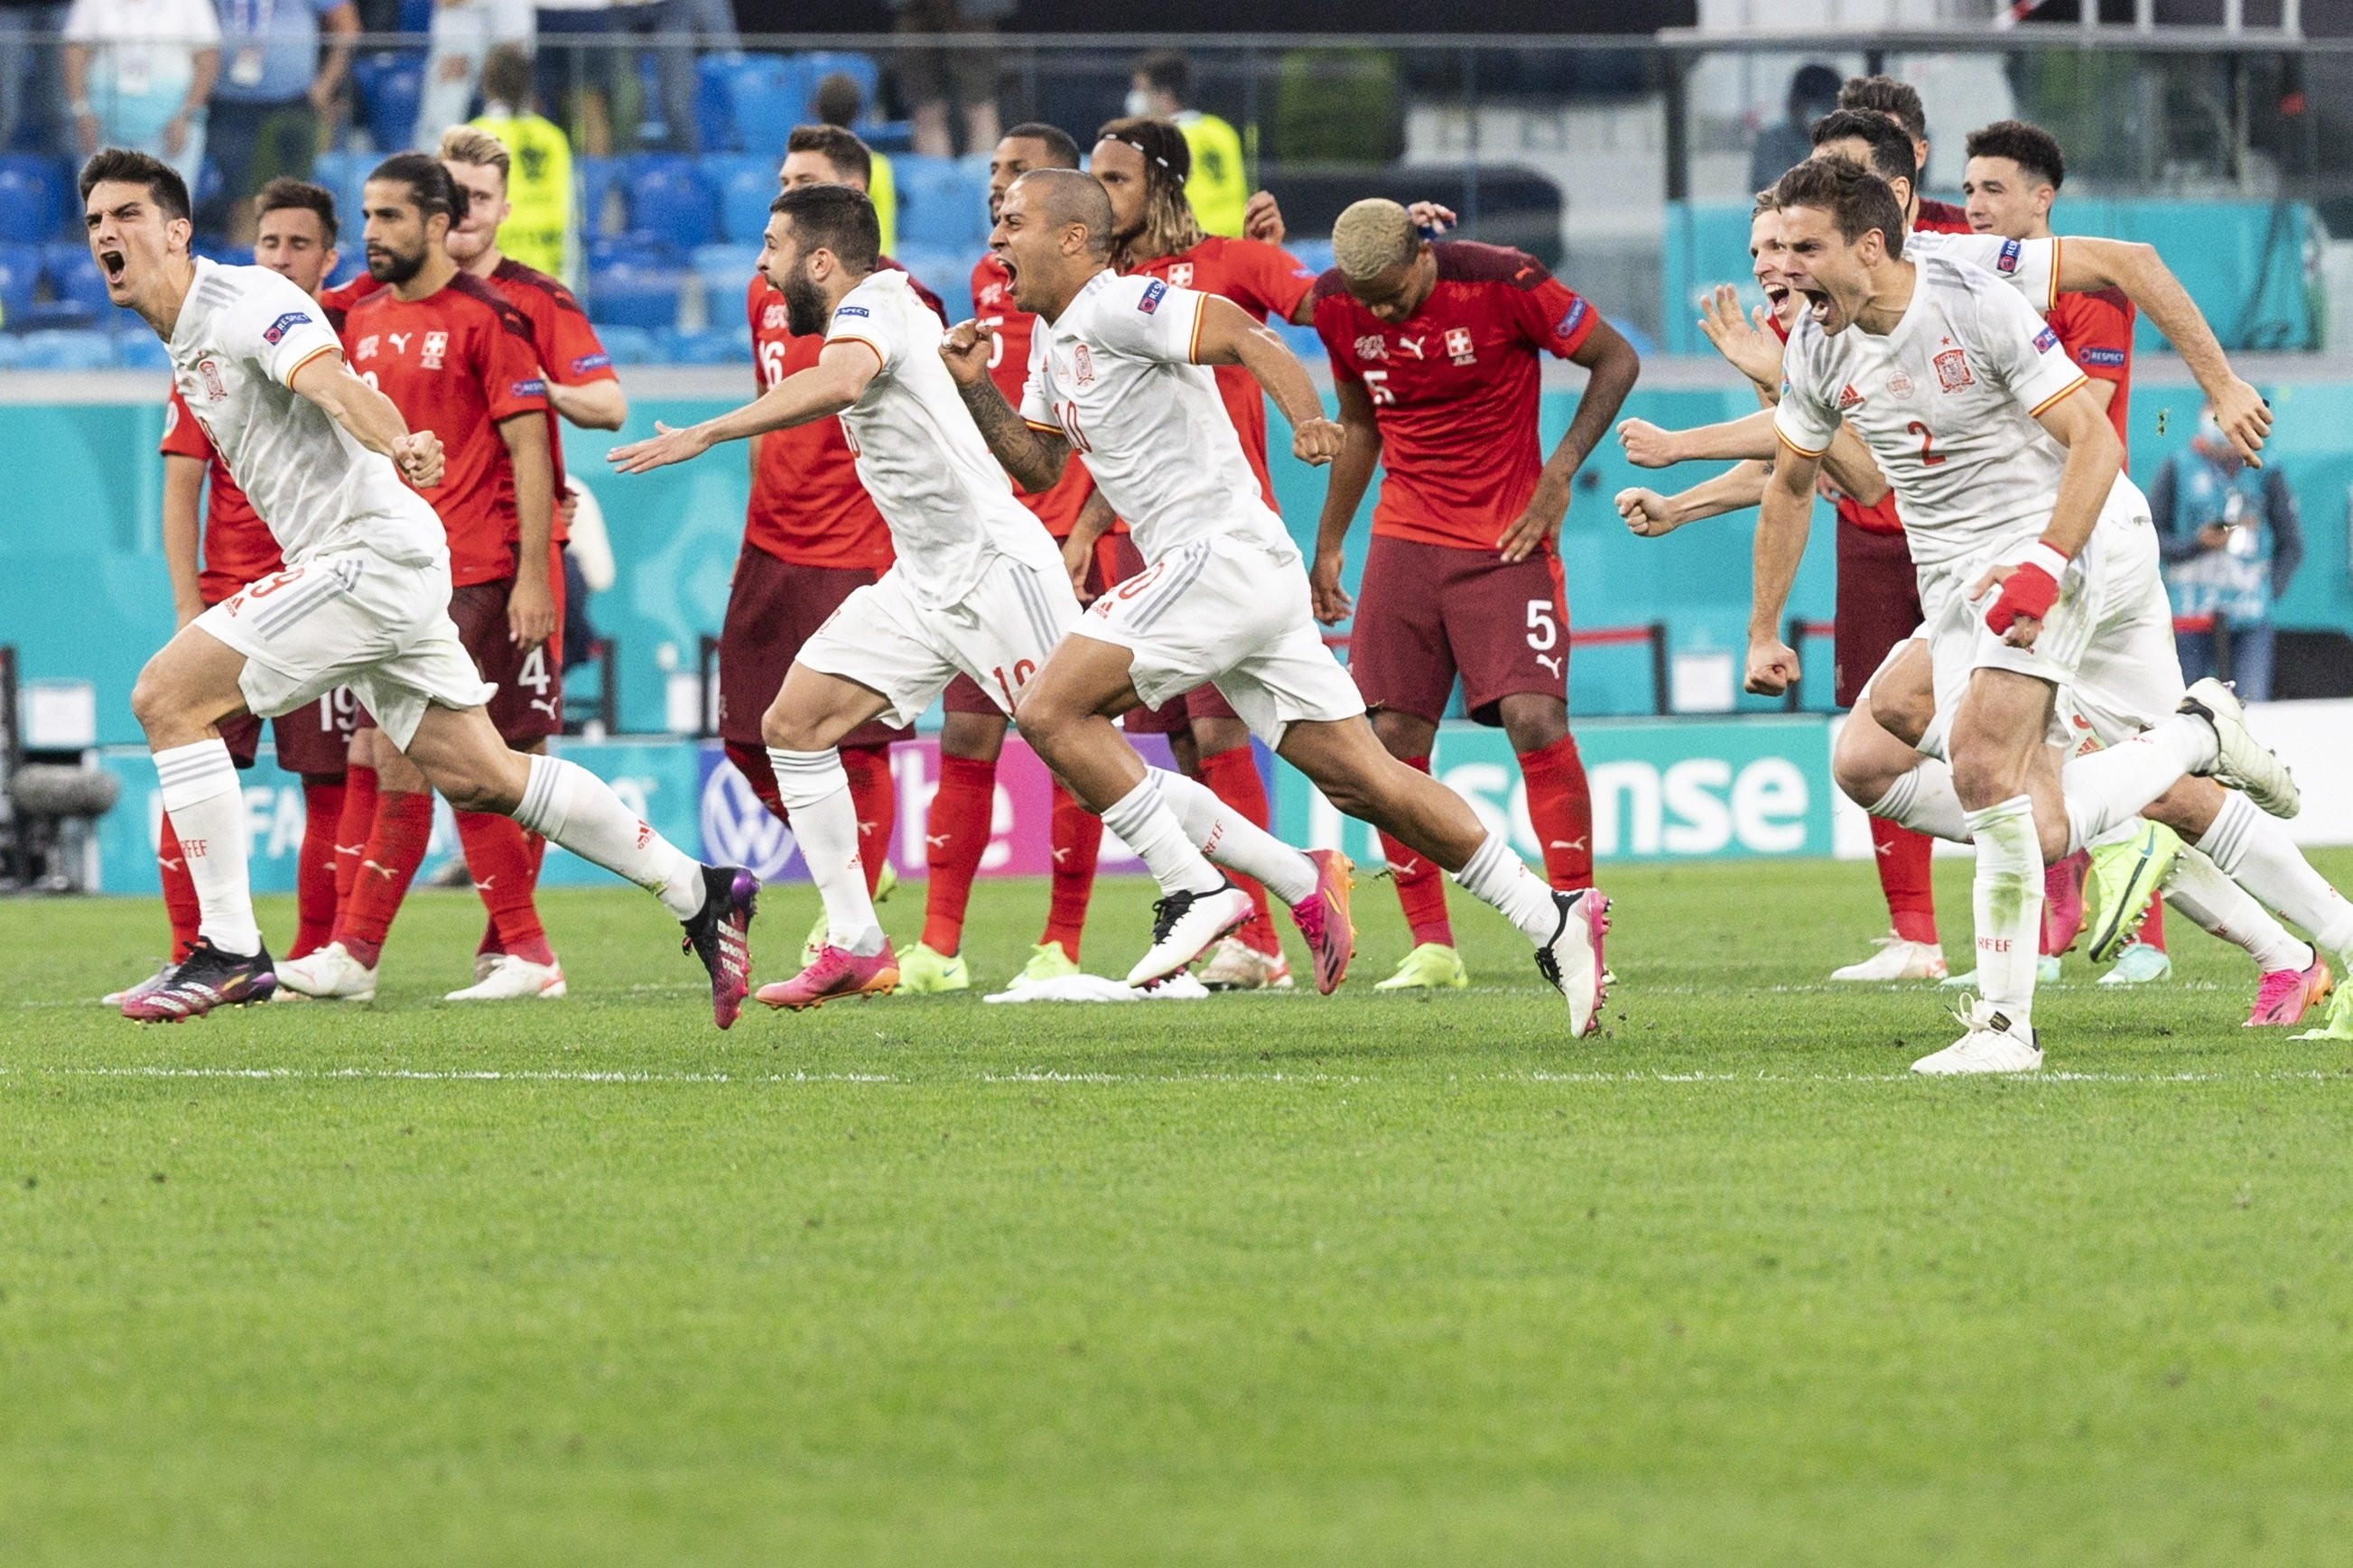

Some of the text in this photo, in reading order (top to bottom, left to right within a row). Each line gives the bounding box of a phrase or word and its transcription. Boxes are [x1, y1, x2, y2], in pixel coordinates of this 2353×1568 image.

[2091, 349, 2125, 361] RESPECT
[1363, 370, 1395, 405] 5
[1907, 421, 1947, 467] 2
[249, 567, 305, 598] 9
[1526, 599, 1557, 651] 5
[517, 645, 552, 696] 4
[319, 683, 359, 733] 19
[1977, 936, 2014, 953] RFEF
